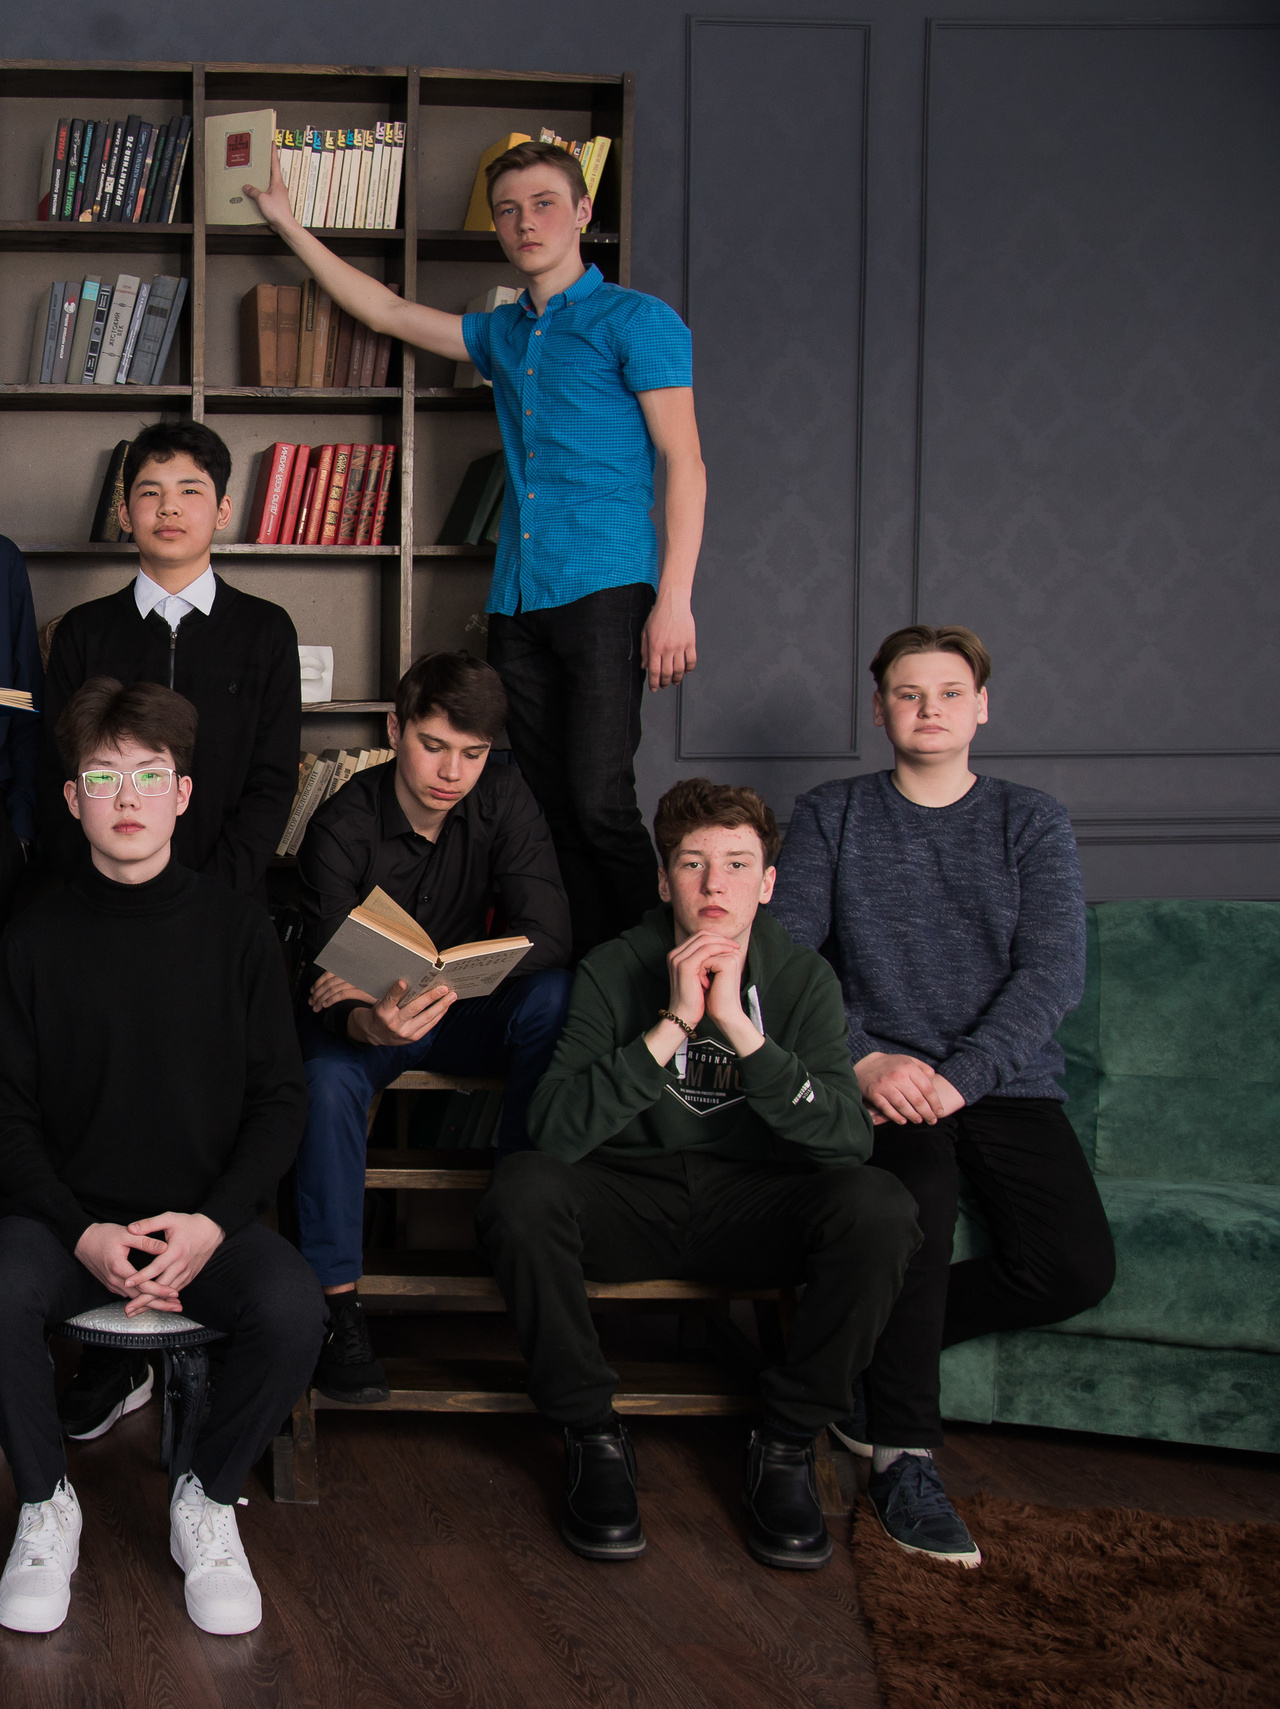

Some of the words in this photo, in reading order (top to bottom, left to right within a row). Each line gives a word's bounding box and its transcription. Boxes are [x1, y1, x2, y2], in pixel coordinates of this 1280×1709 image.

[109, 311, 121, 347] ЖЕСТОКИЙ
[116, 325, 124, 336] ВЕК
[278, 446, 289, 474] ЖИЗНИ
[274, 473, 284, 493] ВСЕЙ
[270, 493, 280, 515] ДЕЛО
[282, 814, 298, 845] ВИКТОР
[688, 1051, 732, 1064] RIGINA
[684, 1095, 720, 1104] OUTSTANDING
